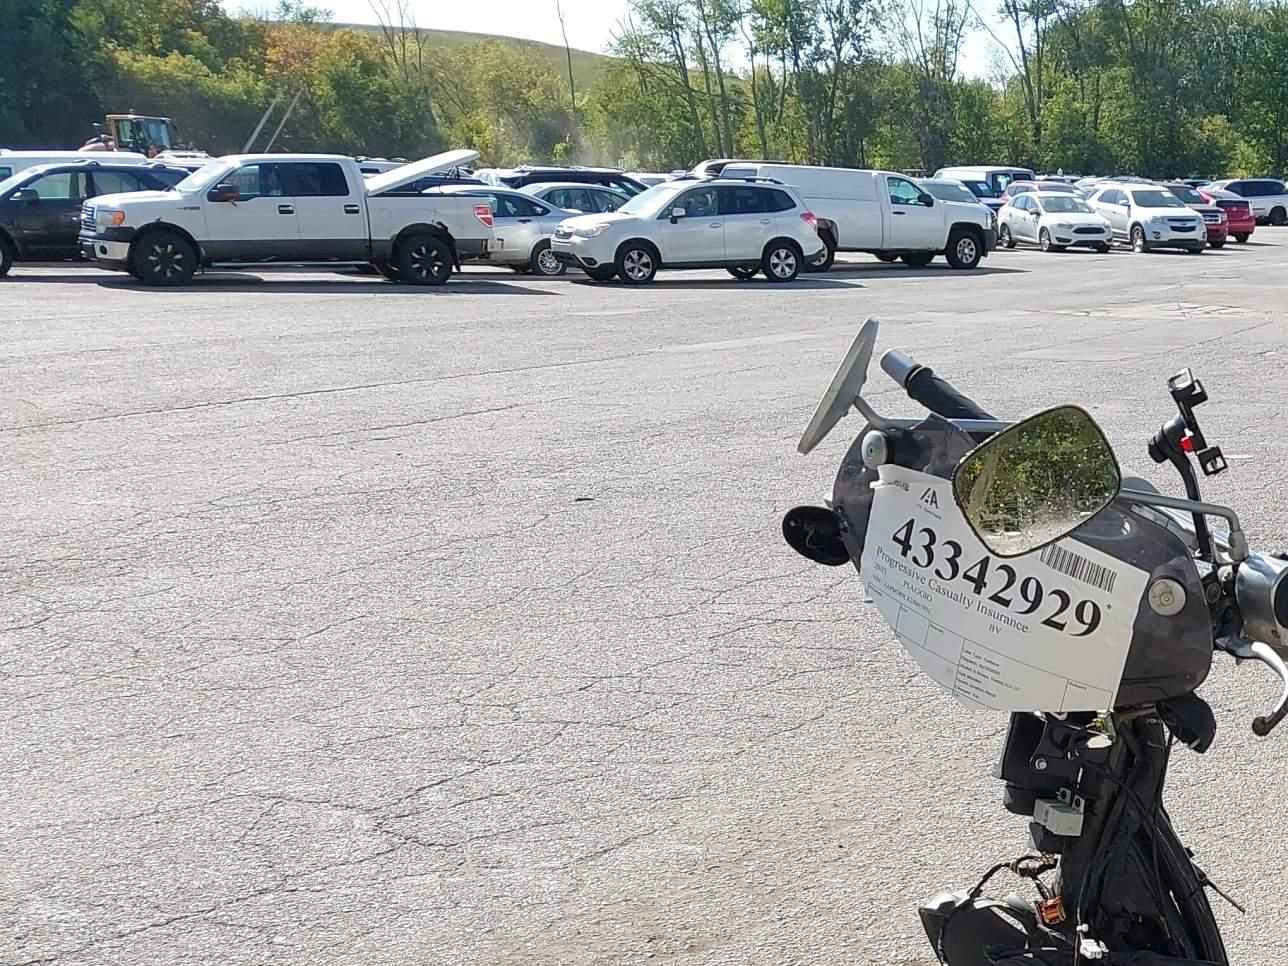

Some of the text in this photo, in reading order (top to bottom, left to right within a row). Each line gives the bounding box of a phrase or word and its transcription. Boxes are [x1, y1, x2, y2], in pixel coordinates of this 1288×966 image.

[876, 545, 926, 584] Progressive
[928, 578, 973, 609] Casualty
[976, 600, 1029, 633] Insurance
[892, 518, 1101, 637] 43342929
[902, 580, 933, 602] PIAGGIO
